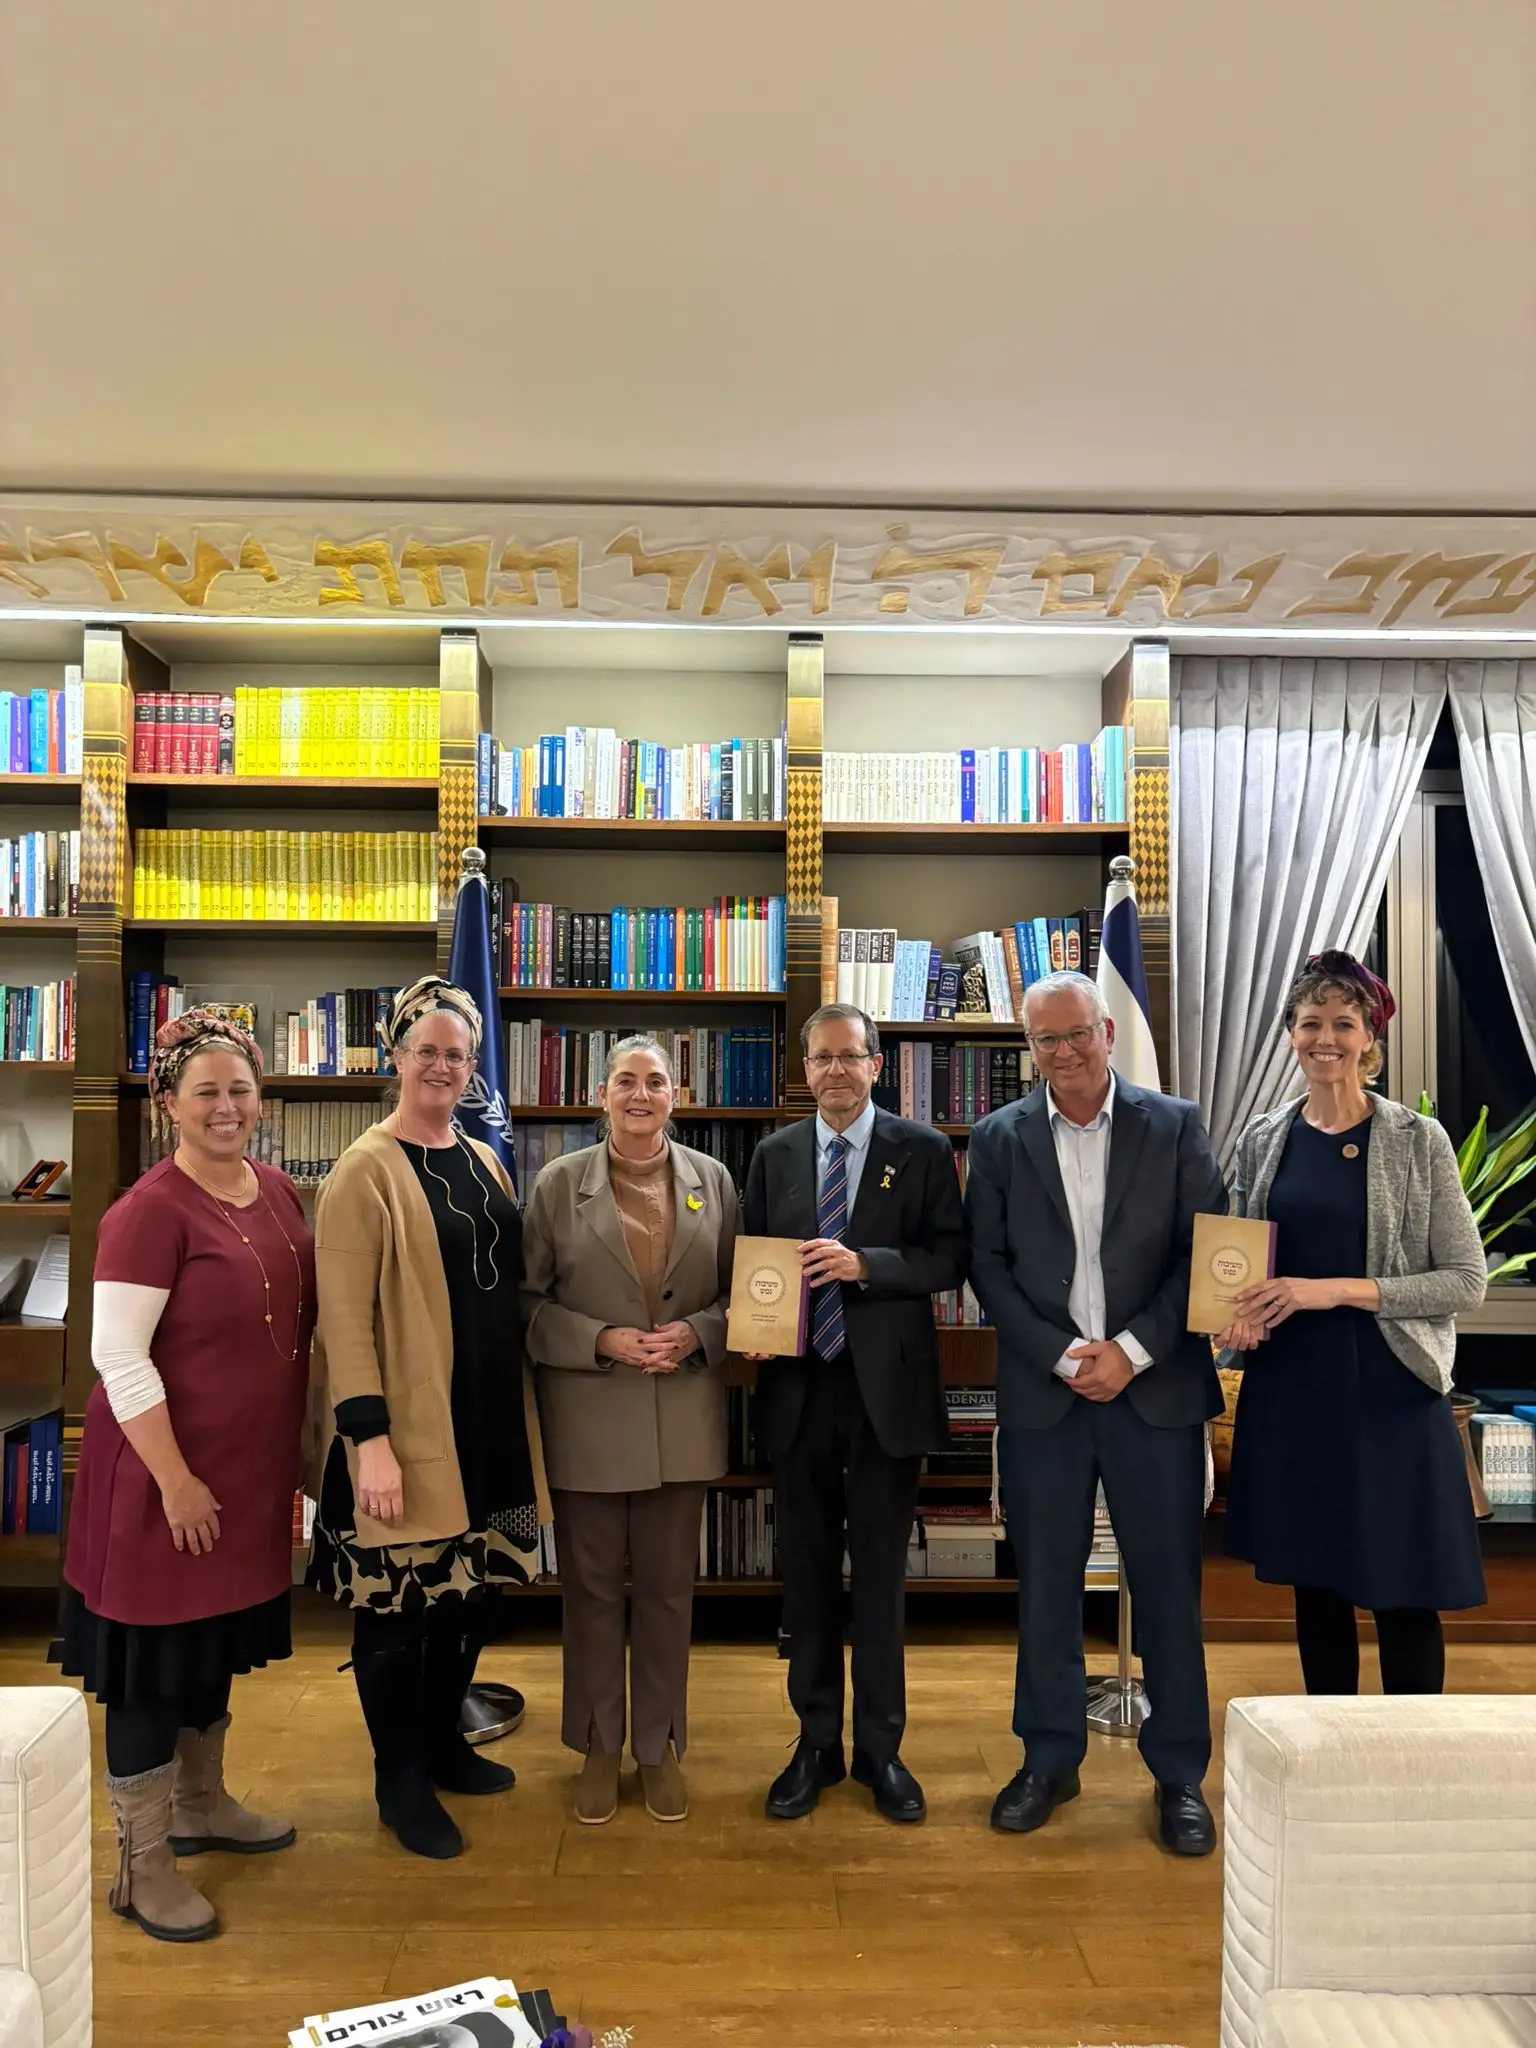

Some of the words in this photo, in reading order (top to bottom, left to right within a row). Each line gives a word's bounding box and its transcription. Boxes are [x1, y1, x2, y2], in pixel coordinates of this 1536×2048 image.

[313, 533, 582, 609] תחת
[603, 526, 836, 616] ואל
[1031, 550, 1287, 619] נאם
[325, 2010, 408, 2043] צורים
[416, 1989, 485, 2016] ראש
